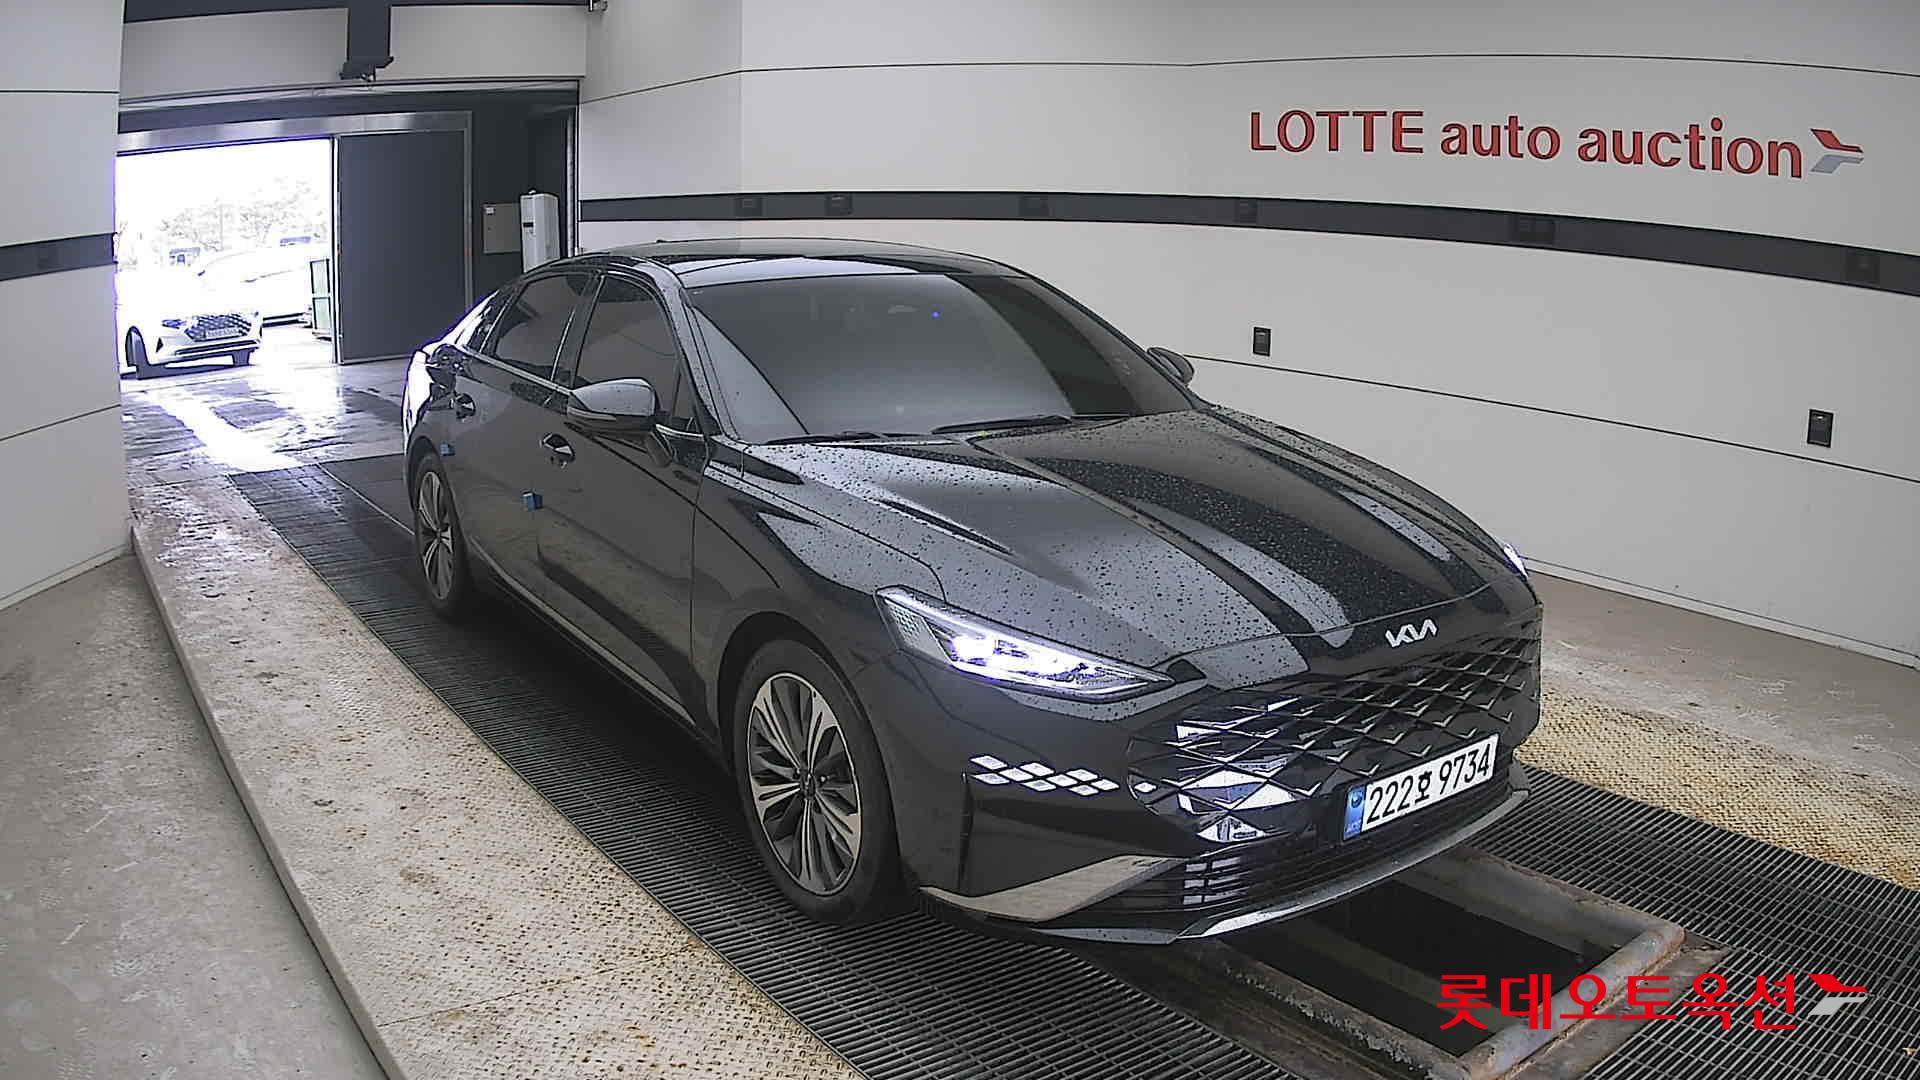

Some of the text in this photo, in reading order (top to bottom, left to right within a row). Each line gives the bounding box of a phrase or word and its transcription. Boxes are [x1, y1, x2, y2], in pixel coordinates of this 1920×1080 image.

[1250, 110, 1803, 179] LOTTE auto auction
[1439, 743, 1491, 796] 9734
